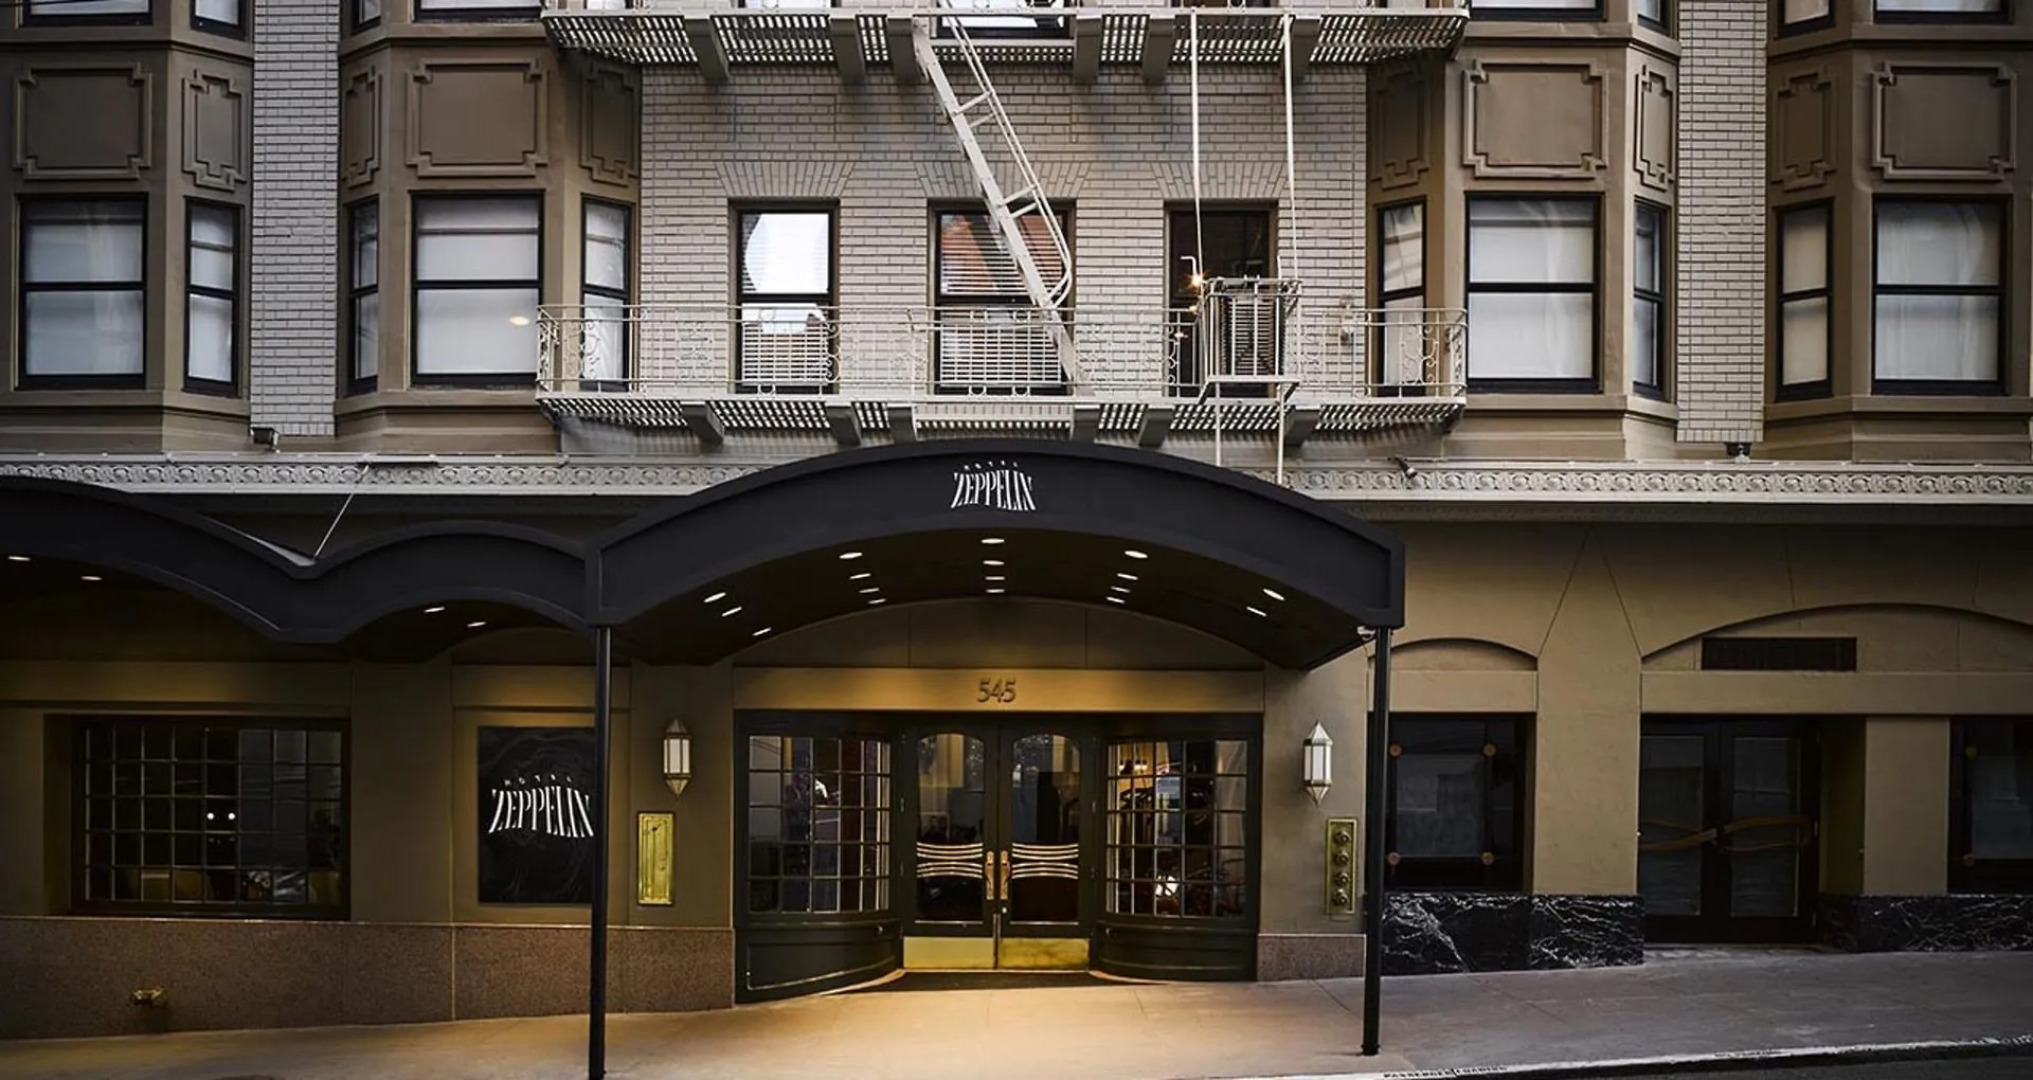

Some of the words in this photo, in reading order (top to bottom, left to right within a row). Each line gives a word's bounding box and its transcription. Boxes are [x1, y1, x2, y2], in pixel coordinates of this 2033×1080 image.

[951, 470, 1036, 511] ZEPPELIN
[977, 678, 1016, 703] 545
[488, 786, 594, 838] ZEPPELIN
